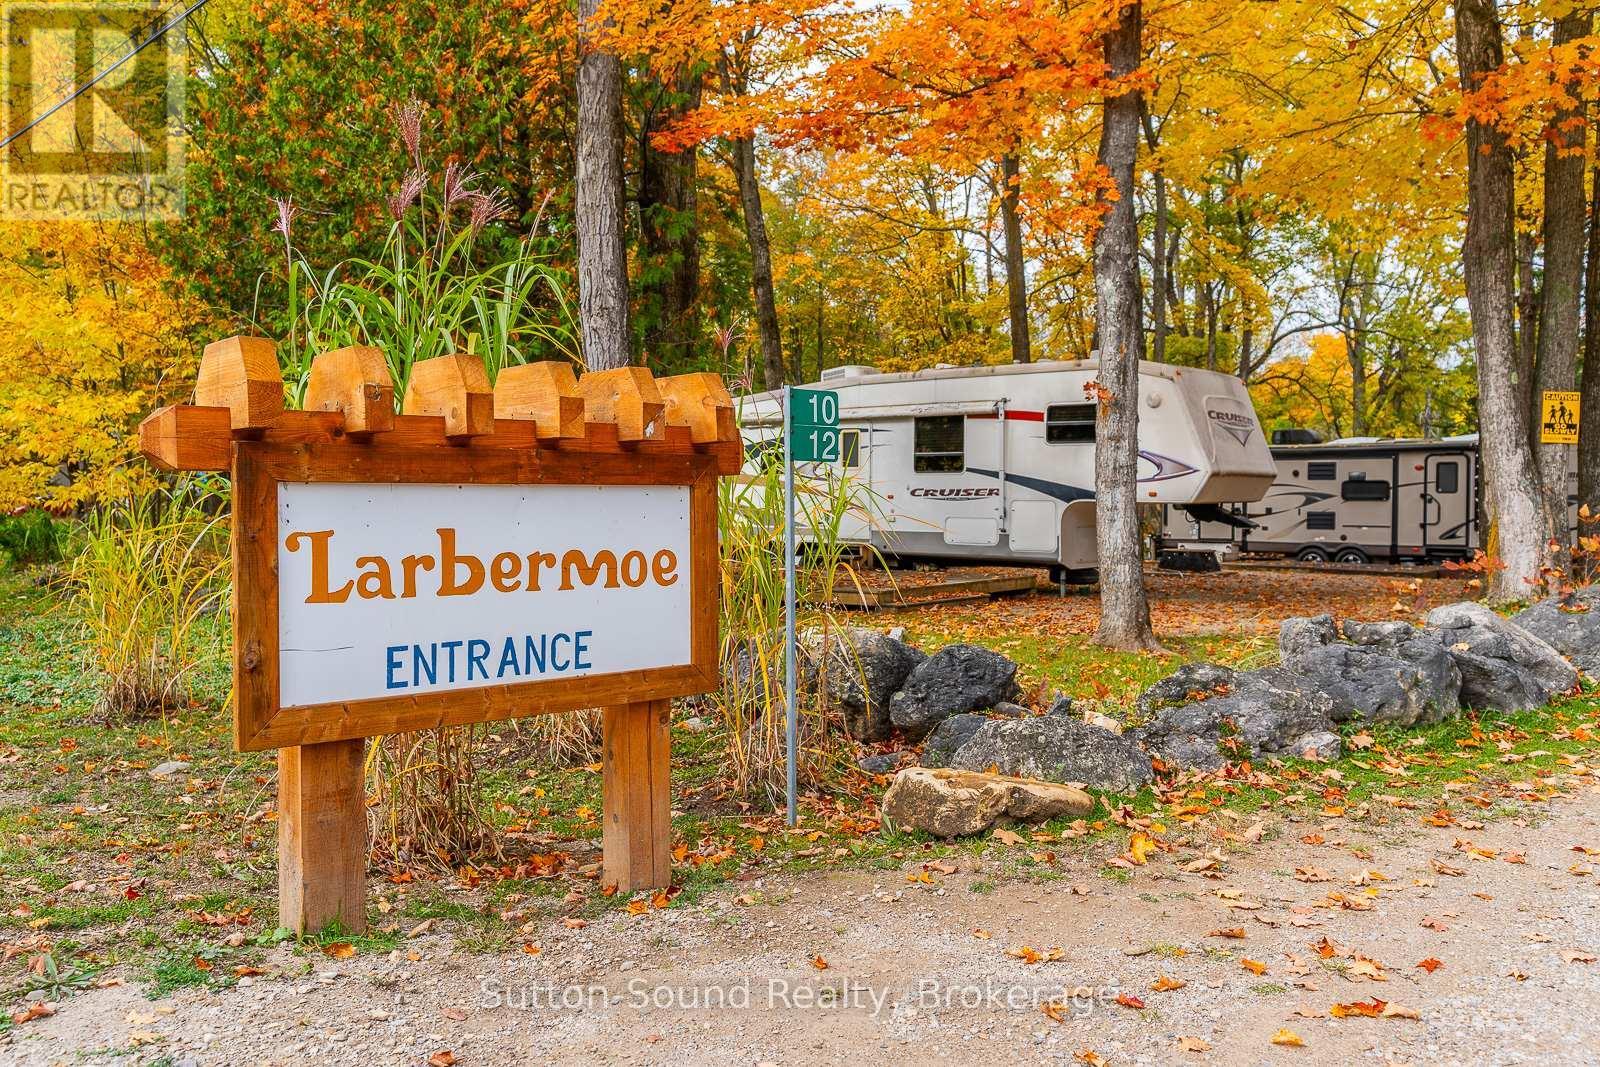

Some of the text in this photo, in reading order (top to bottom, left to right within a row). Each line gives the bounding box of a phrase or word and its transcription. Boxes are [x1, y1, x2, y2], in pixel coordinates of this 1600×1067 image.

[809, 394, 836, 425] 10
[809, 430, 836, 460] 12
[910, 488, 1000, 497] CRUISER
[285, 528, 679, 604] Larbermoe
[385, 630, 593, 690] ENTRANCE
